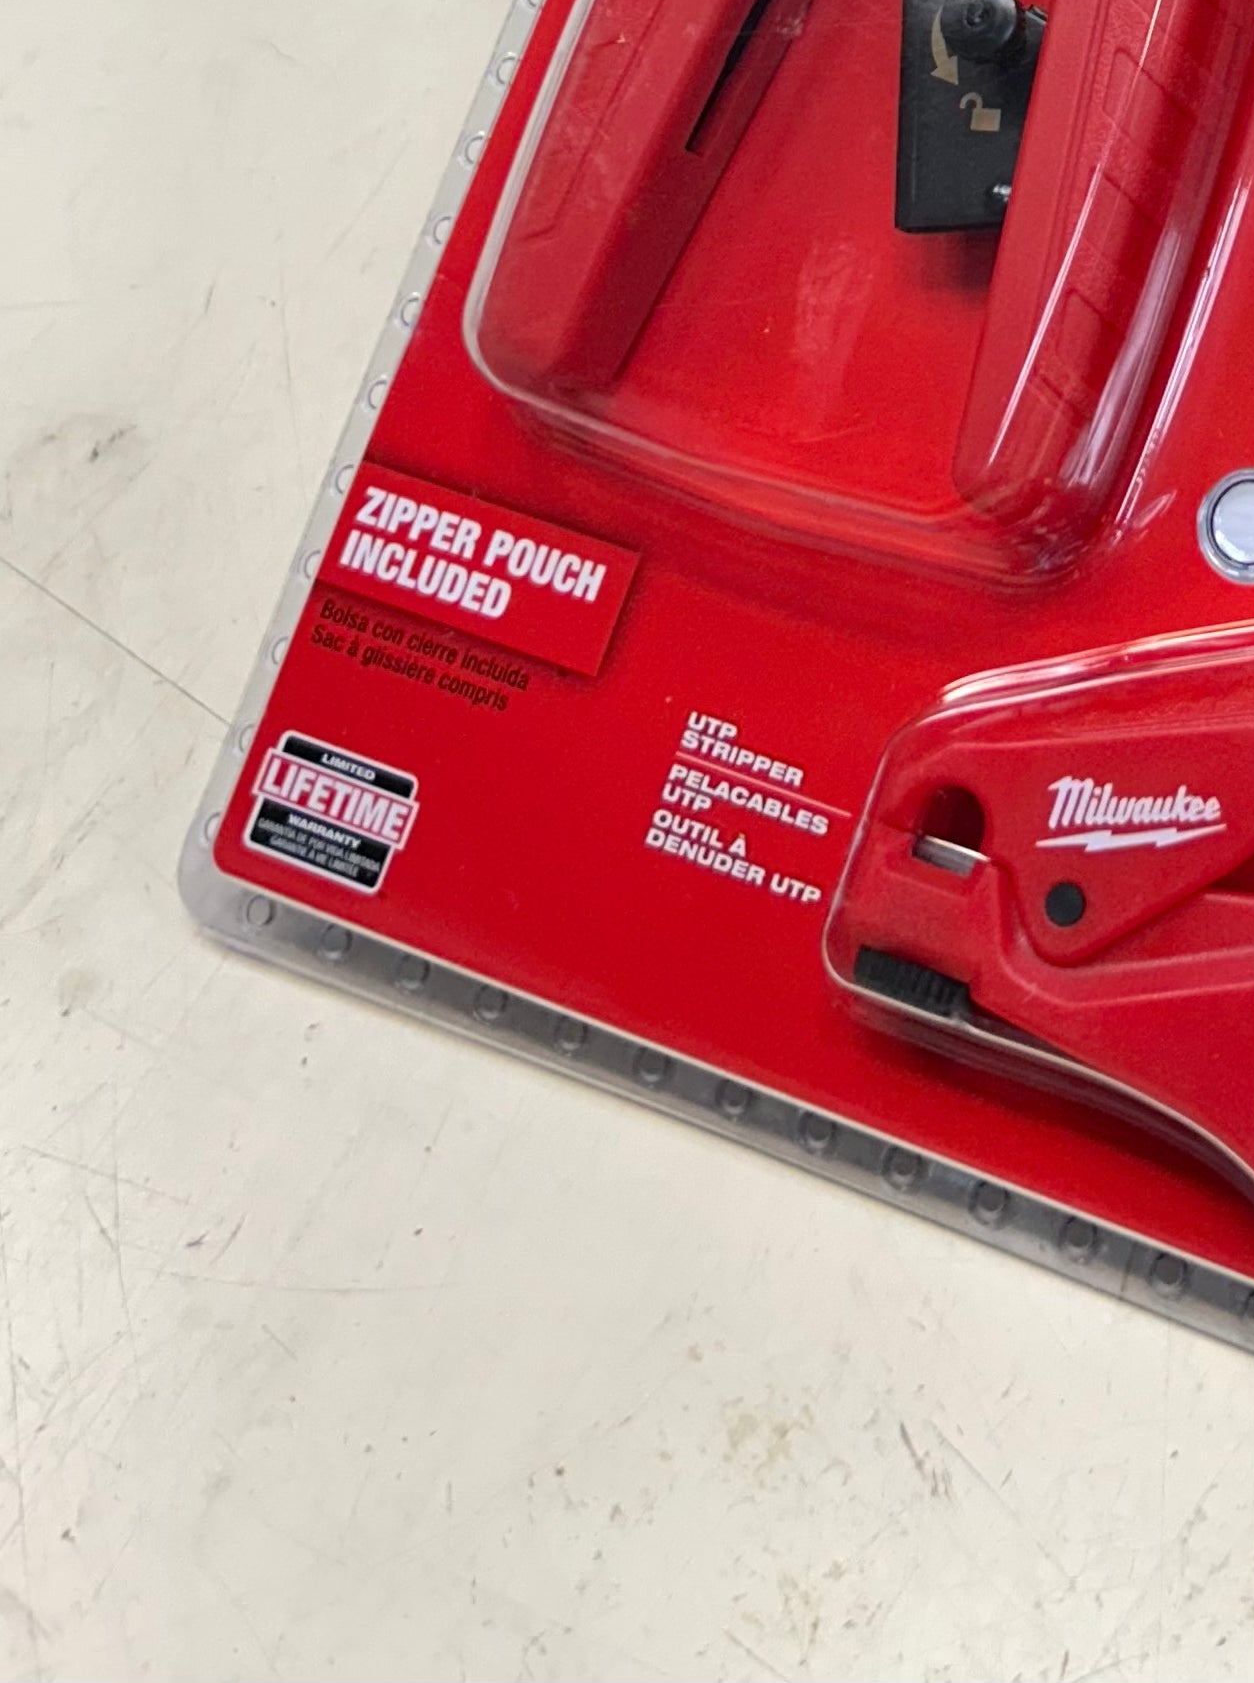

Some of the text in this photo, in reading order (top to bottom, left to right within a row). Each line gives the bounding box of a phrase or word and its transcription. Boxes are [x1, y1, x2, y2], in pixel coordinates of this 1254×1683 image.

[338, 529, 512, 619] INCLUDED
[355, 485, 607, 603] ZIPPER POUCH
[319, 598, 367, 634] Bolsa
[371, 618, 404, 645] con
[405, 630, 460, 664] cierre
[310, 623, 510, 712] Sac à glissière compris
[687, 711, 738, 740] UTP
[321, 752, 376, 782] LIMITED
[680, 729, 804, 787] STRIPPER
[261, 757, 410, 841] LIFETIME
[661, 782, 712, 812] UTP
[667, 762, 830, 836] PELACABLES
[1047, 775, 1223, 830] Milwaukee
[288, 813, 362, 849] WARRANTY
[652, 807, 747, 858] OUTIL À
[644, 826, 823, 903] DENUDER UTP
